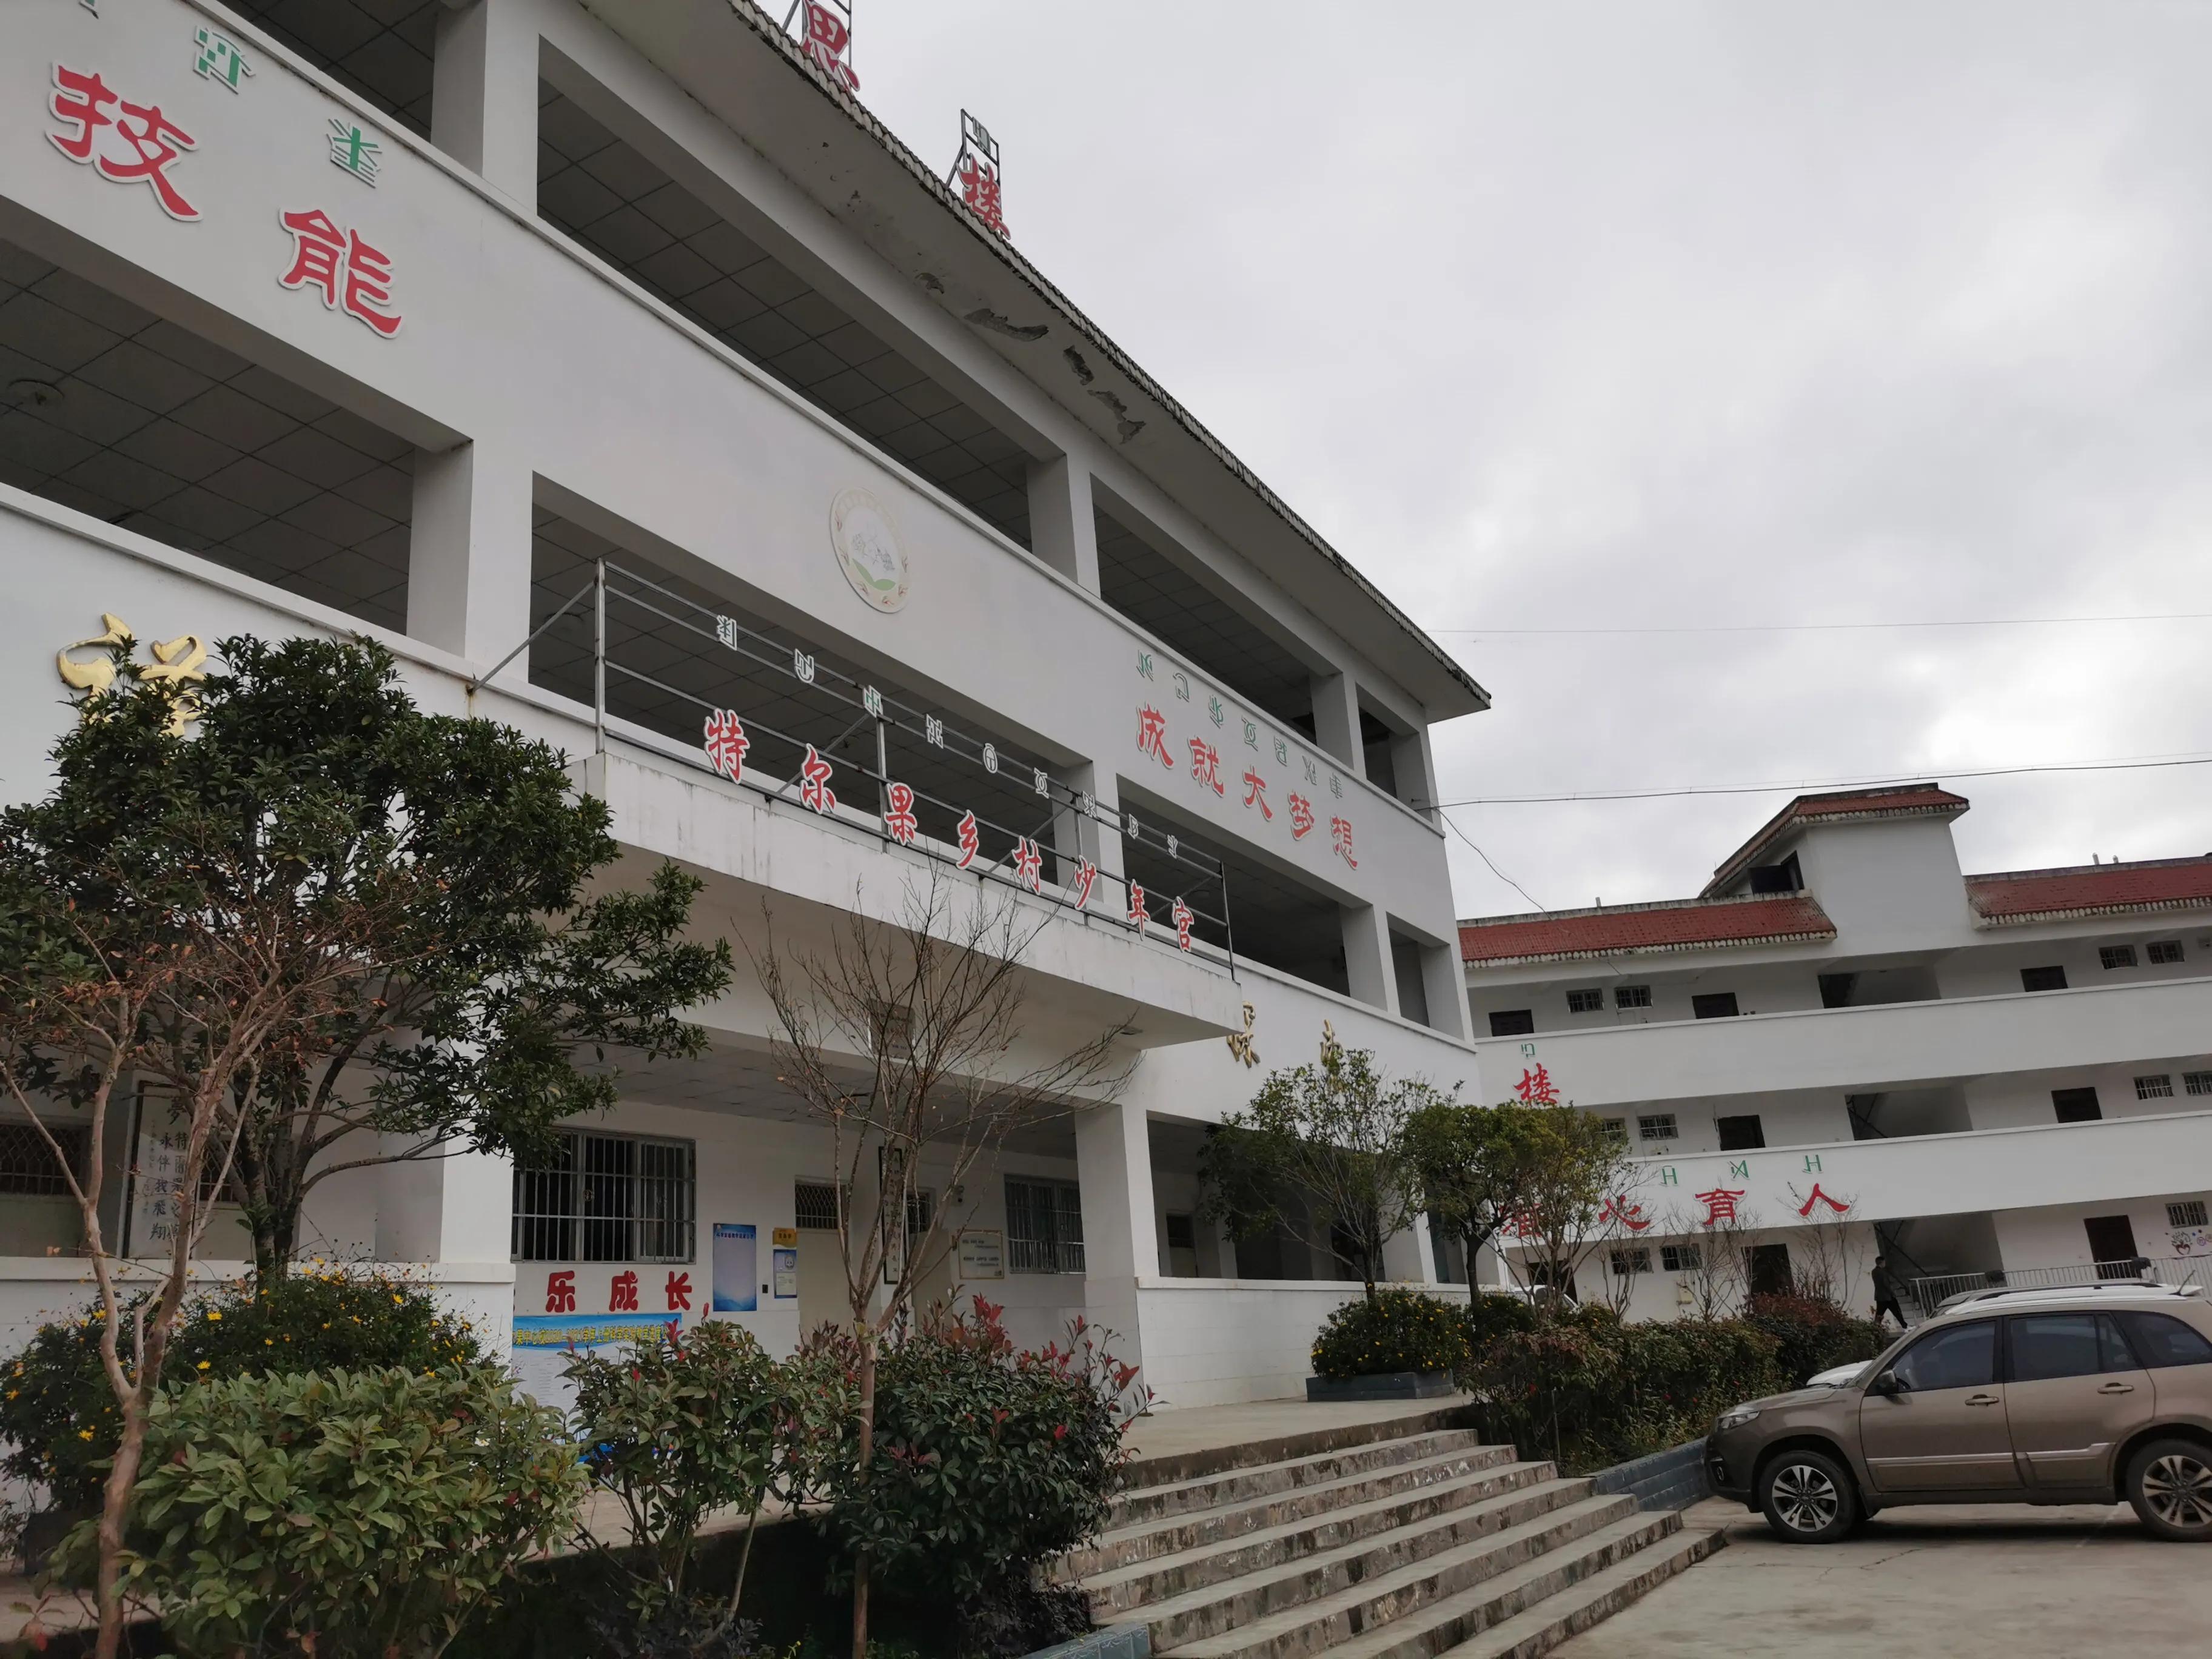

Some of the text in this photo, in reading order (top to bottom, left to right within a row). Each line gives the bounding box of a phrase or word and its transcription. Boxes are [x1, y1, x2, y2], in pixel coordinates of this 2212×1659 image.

[46, 61, 403, 338] 技能
[703, 707, 1195, 953] 特尔果乡村少年宫
[1137, 704, 1358, 870] 成就大梦想
[513, 1270, 692, 1313] 乐成长
